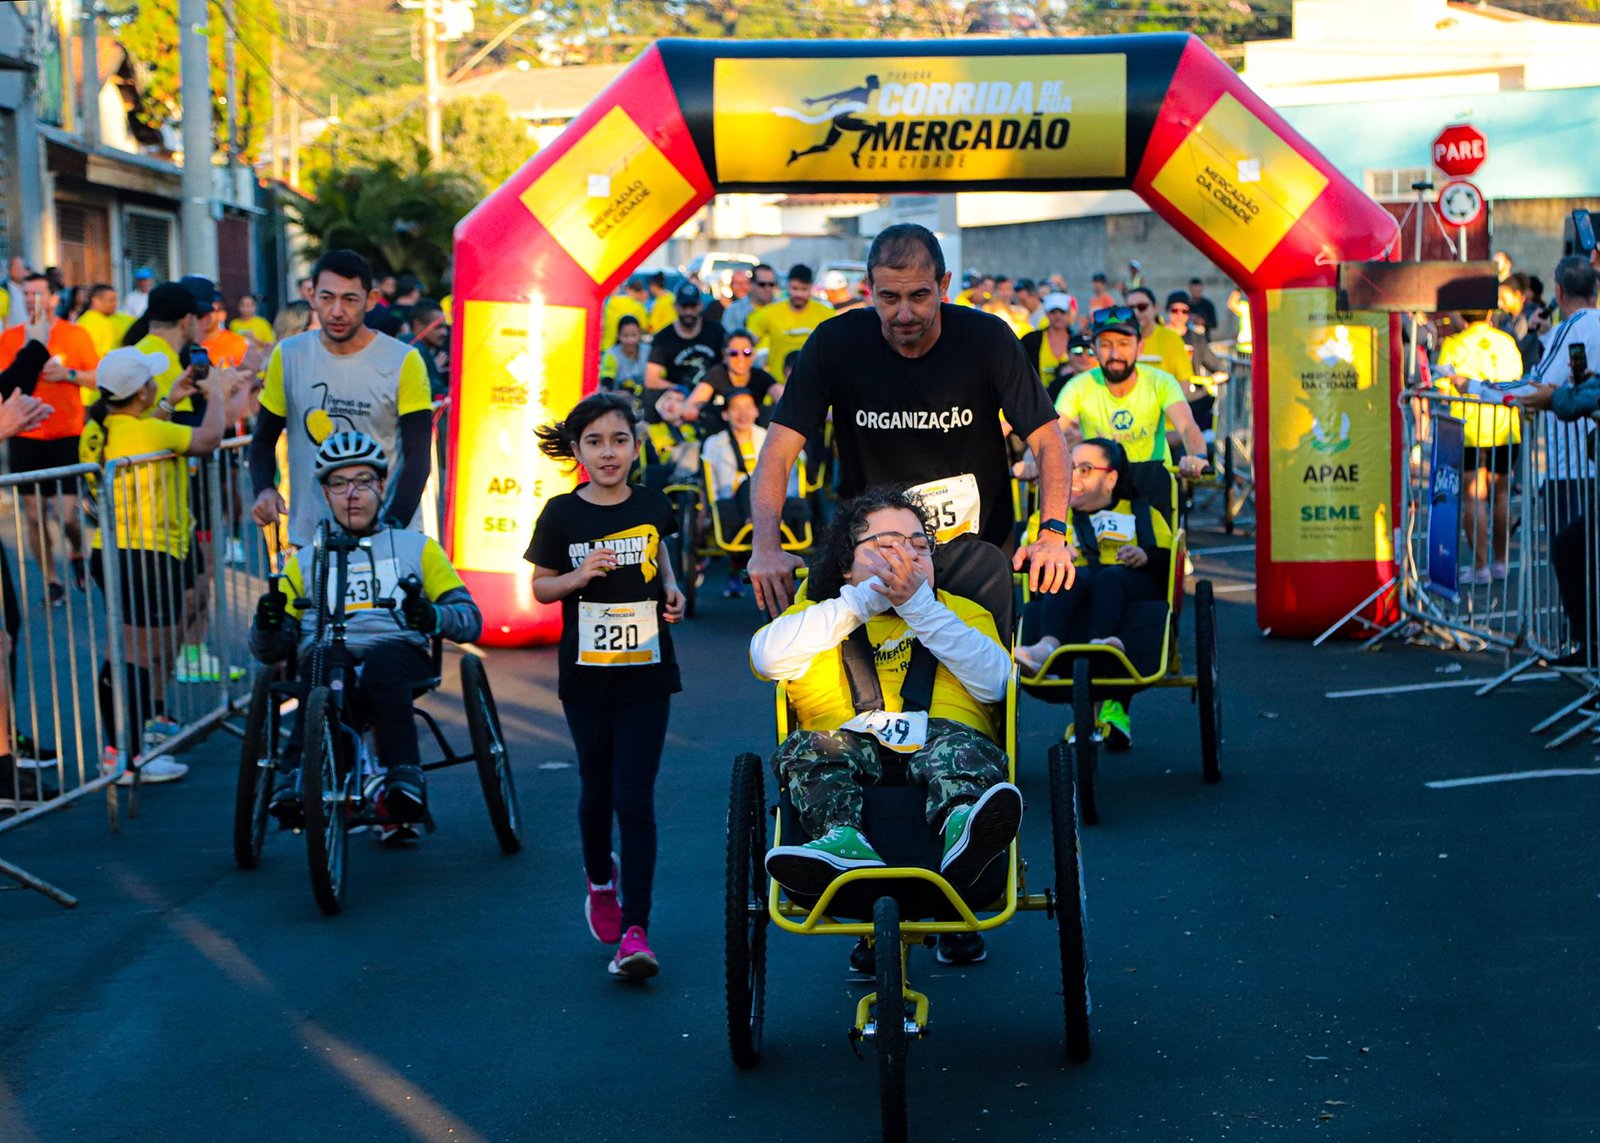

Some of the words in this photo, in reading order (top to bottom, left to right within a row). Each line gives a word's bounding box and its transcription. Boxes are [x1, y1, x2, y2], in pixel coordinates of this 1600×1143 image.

[877, 80, 1034, 117] CORRIDA
[1041, 80, 1064, 96] DE
[871, 112, 1070, 151] MERCADÃO
[867, 155, 889, 169] DA
[899, 154, 967, 169] CIDADE
[1434, 139, 1484, 163] PARE
[1196, 174, 1212, 192] DA
[1213, 188, 1254, 225] CIDADE
[1204, 165, 1260, 215] MERCADÃO
[588, 180, 643, 230] MERCADÃO
[597, 224, 614, 240] DA
[612, 188, 651, 224] CIDADE
[1301, 370, 1359, 380] MERCADÃO
[1302, 382, 1317, 390] DA
[1319, 382, 1358, 390] CIDADE
[855, 406, 973, 433] ORGANIZAÇÃO
[1303, 464, 1360, 483] APAE
[1300, 505, 1361, 521] SEME
[594, 624, 638, 650] 220
[876, 638, 913, 661] MERCA
[866, 719, 910, 744] 49
